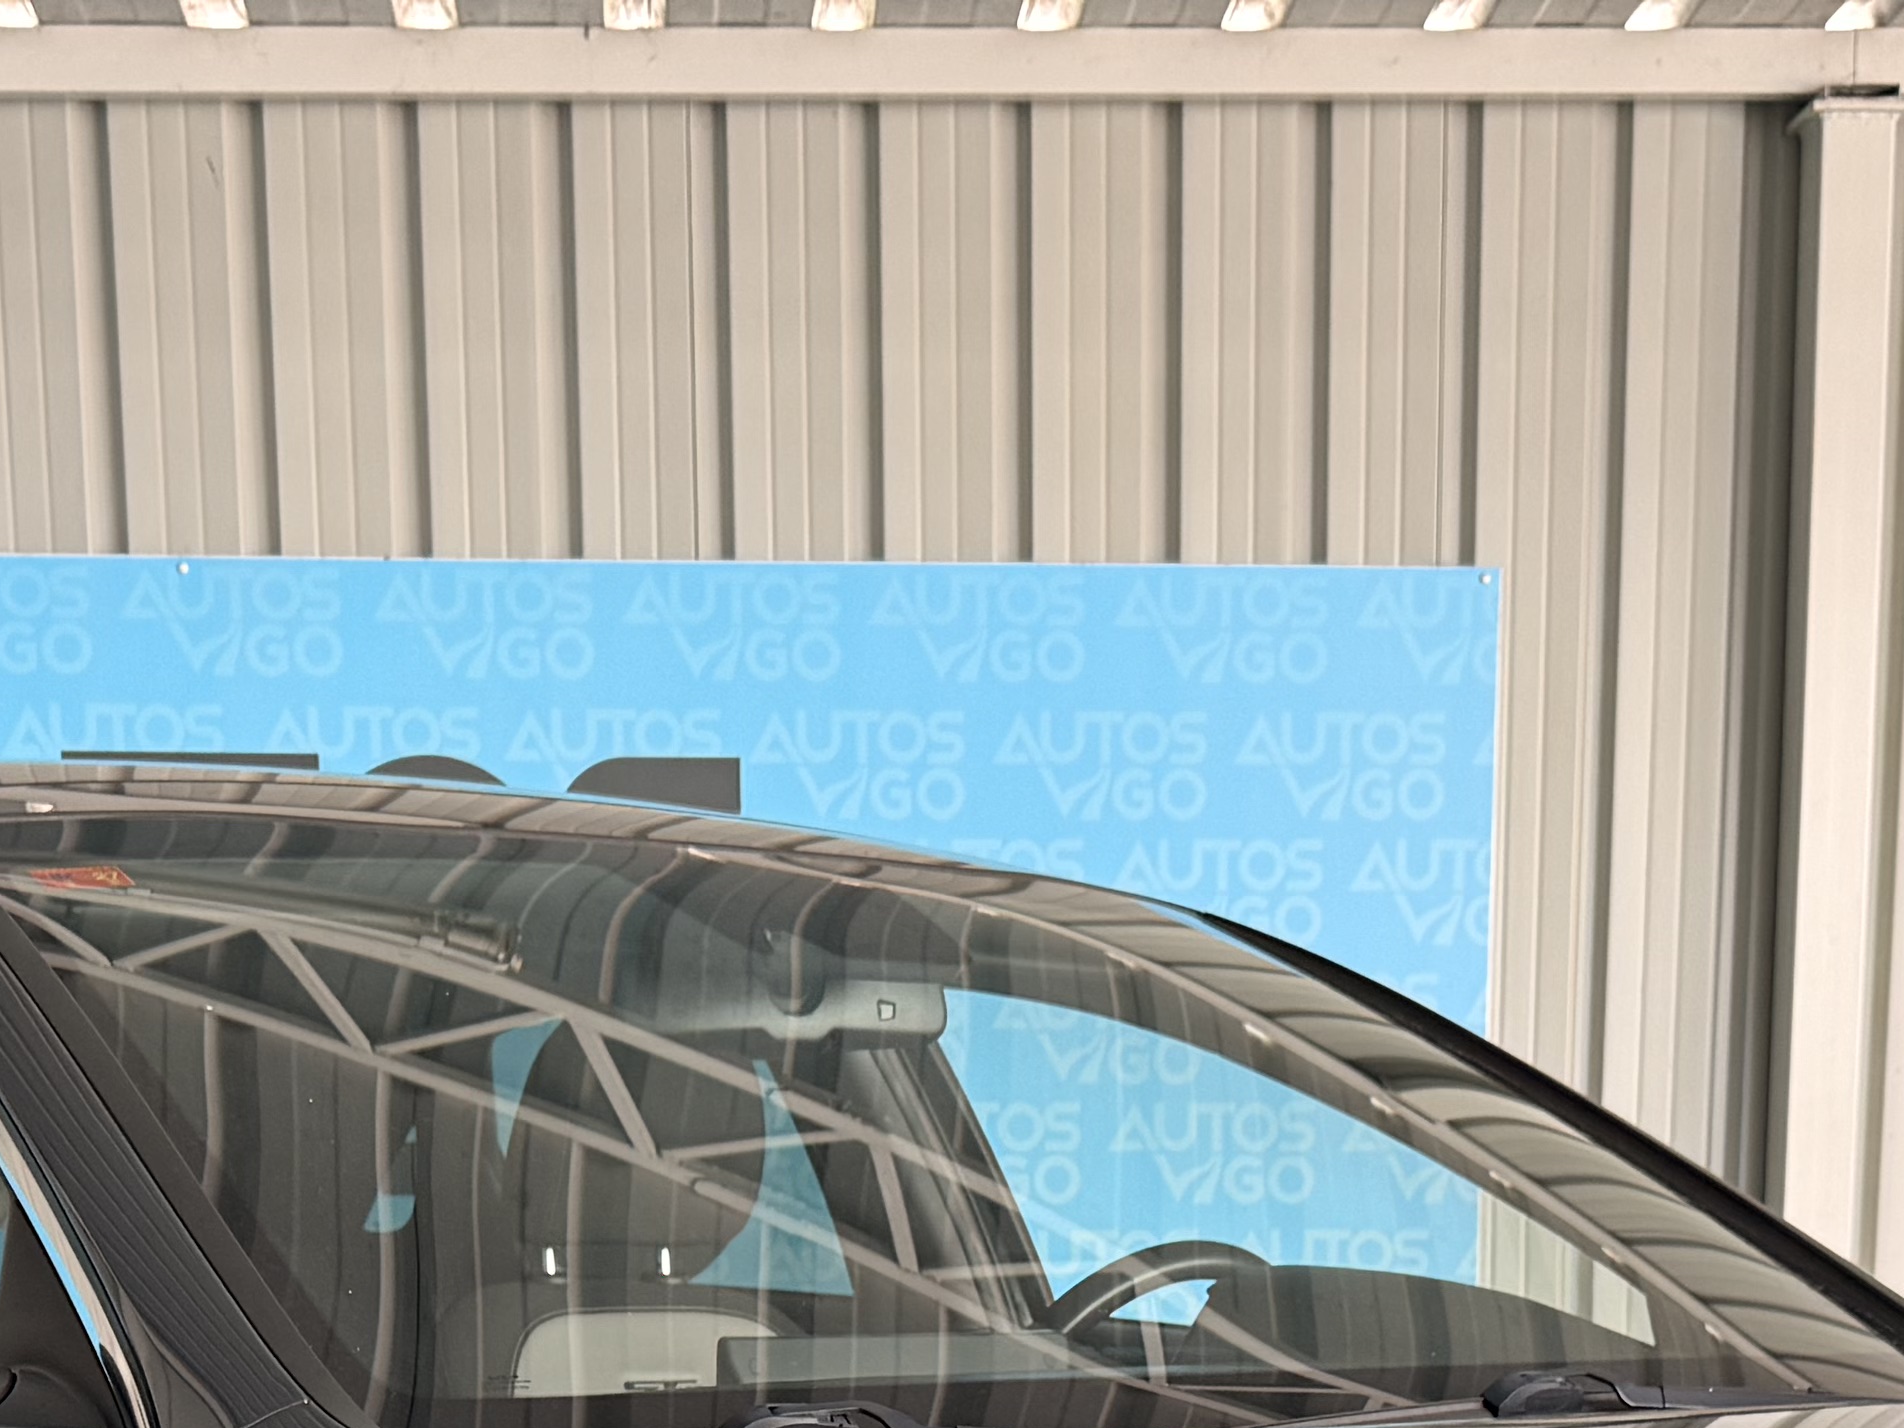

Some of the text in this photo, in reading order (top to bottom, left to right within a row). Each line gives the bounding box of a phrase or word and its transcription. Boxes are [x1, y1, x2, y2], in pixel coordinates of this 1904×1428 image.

[121, 565, 342, 621] AUTOS
[374, 567, 593, 624] AUTOS
[621, 569, 840, 626] AUTOS
[867, 572, 1085, 628] AUTOS
[1115, 574, 1329, 629] AUTOS
[166, 621, 344, 678] VIGO
[423, 625, 594, 680] VIGO
[671, 627, 842, 682] VIGO
[918, 628, 1084, 683] VIGO
[1160, 629, 1329, 684] VIGO
[4, 703, 225, 756] AUTOS
[264, 704, 482, 758] AUTOS
[503, 707, 723, 761] AUTOS
[749, 709, 966, 765] AUTOS
[996, 710, 1209, 766] AUTOS
[1235, 711, 1446, 766] AUTOS
[796, 766, 967, 821] VIGO
[1038, 766, 1209, 821] VIGO
[1278, 767, 1445, 821] VIGO
[1109, 1103, 1317, 1152] AUTOS
[1153, 1154, 1315, 1204] VIGO
